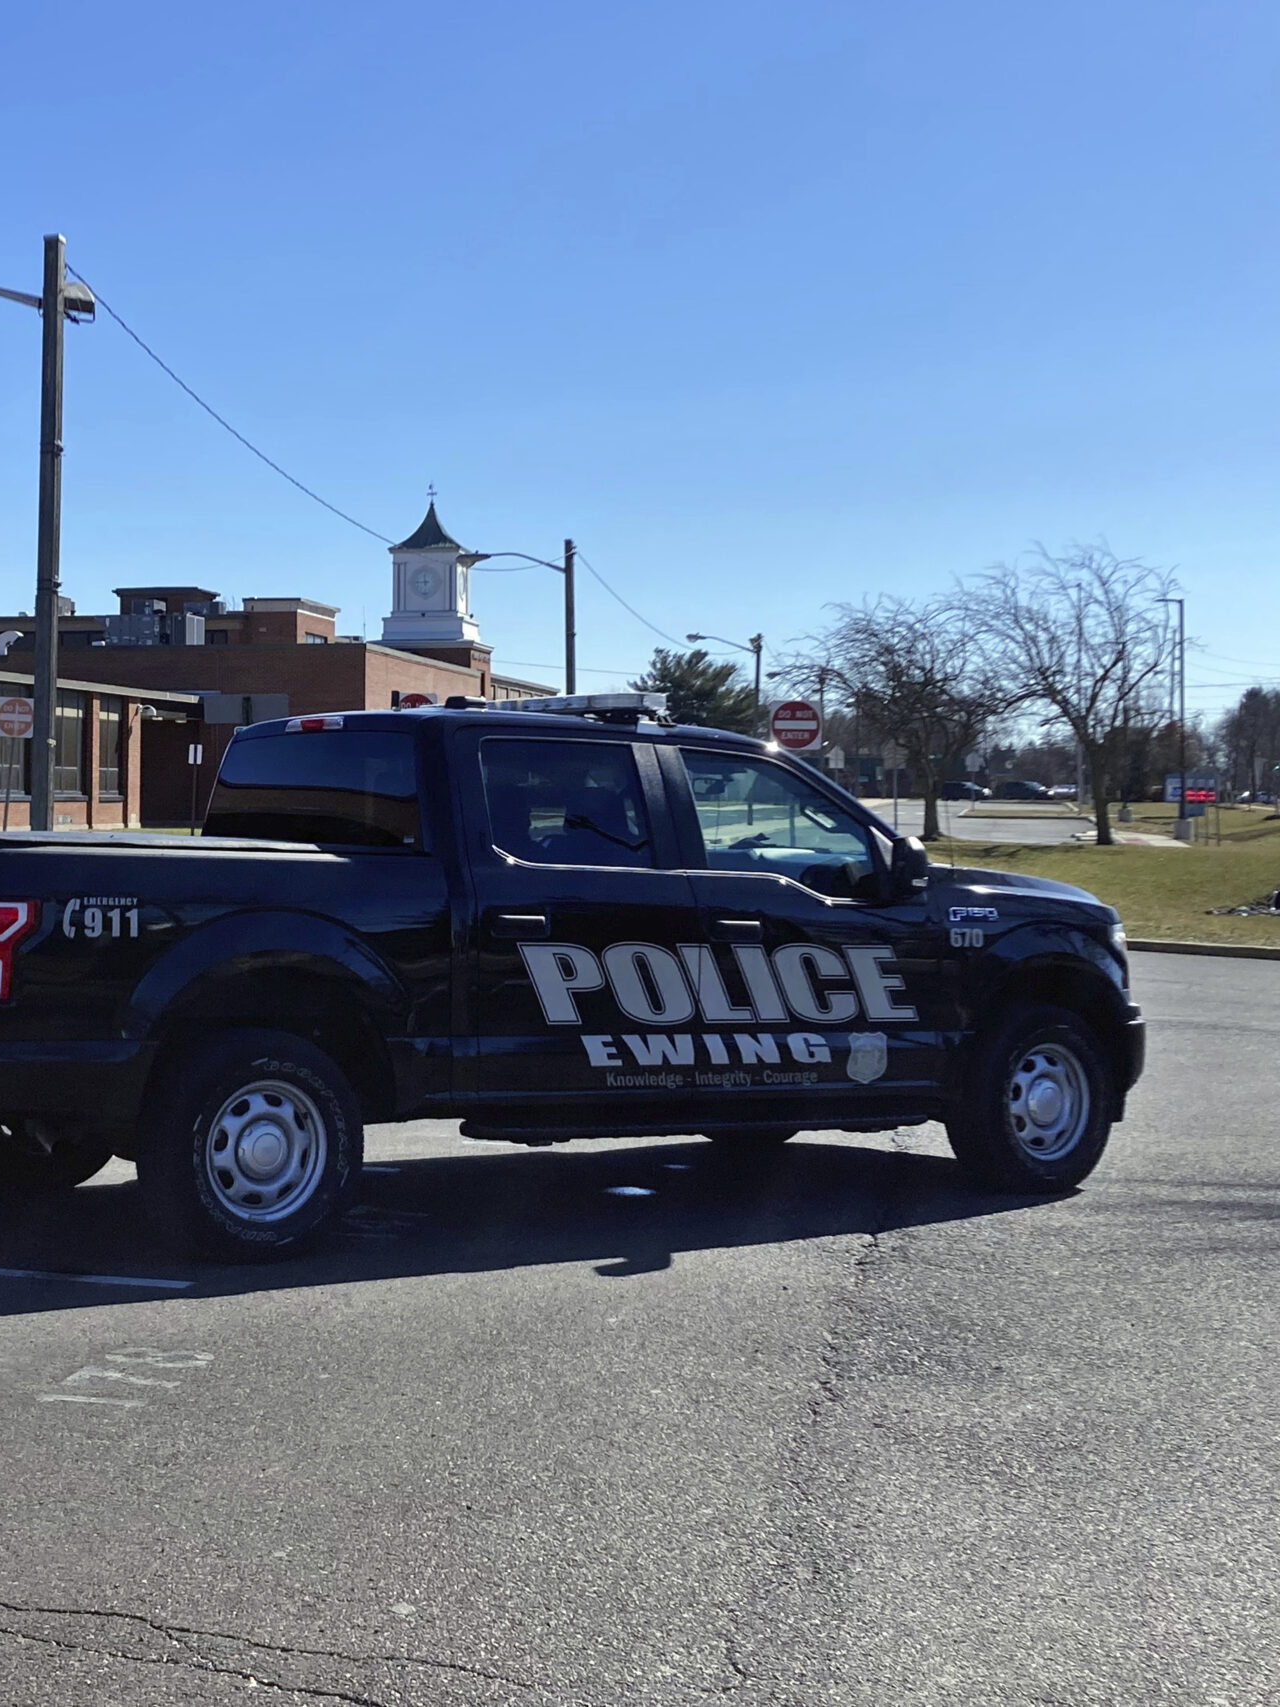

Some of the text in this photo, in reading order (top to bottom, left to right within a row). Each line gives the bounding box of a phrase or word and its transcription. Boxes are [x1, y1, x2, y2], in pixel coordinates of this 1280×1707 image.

[3, 704, 13, 712] DO
[778, 710, 812, 718] DO NOT
[781, 731, 810, 740] ENTER
[84, 907, 139, 938] 911
[949, 927, 984, 948] 670
[517, 942, 919, 1025] POLICE
[580, 1032, 832, 1067] EWING
[606, 1071, 684, 1089] Knowledge
[695, 1070, 752, 1087] Integrity
[763, 1069, 819, 1086] Courage
